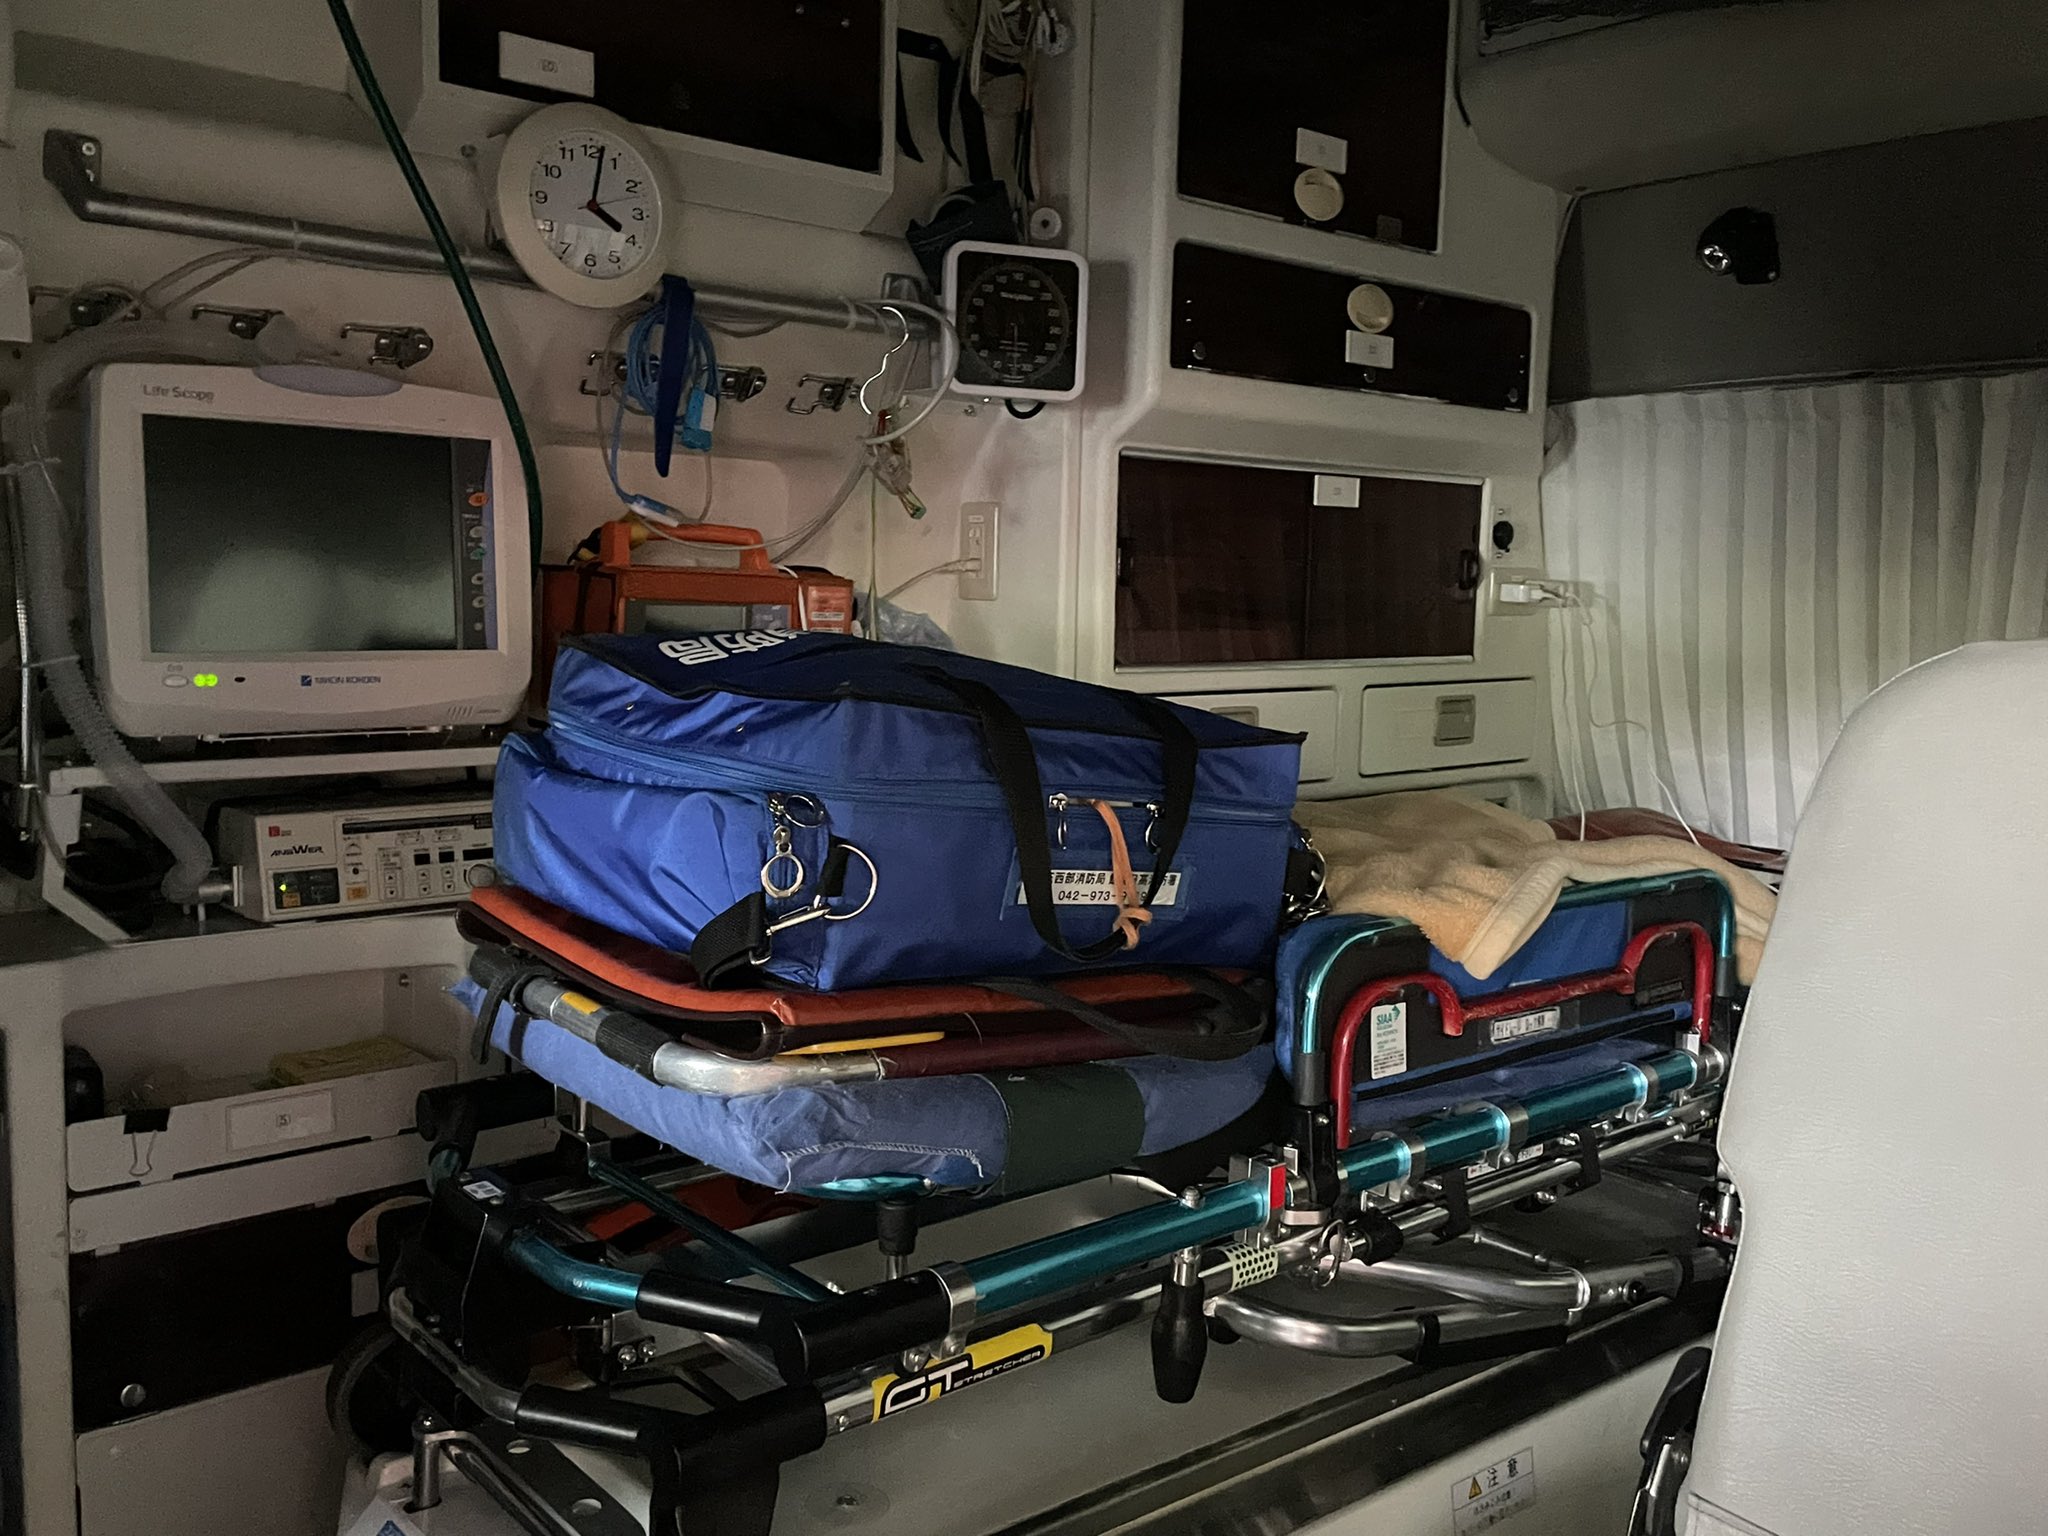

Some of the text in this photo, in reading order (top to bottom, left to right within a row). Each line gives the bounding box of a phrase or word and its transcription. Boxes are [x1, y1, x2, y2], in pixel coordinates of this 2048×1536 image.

[559, 147, 574, 161] 11
[580, 144, 600, 159] 12
[610, 157, 618, 170] 1
[542, 164, 562, 179] 10
[625, 179, 638, 193] 2
[535, 190, 548, 204] 9
[632, 207, 644, 221] 3
[625, 234, 636, 246] 4
[559, 241, 572, 255] 7
[584, 253, 597, 267] 6
[608, 250, 621, 264] 5
[1051, 871, 1106, 885] 西部消防局
[1376, 1013, 1393, 1026] SIAA
